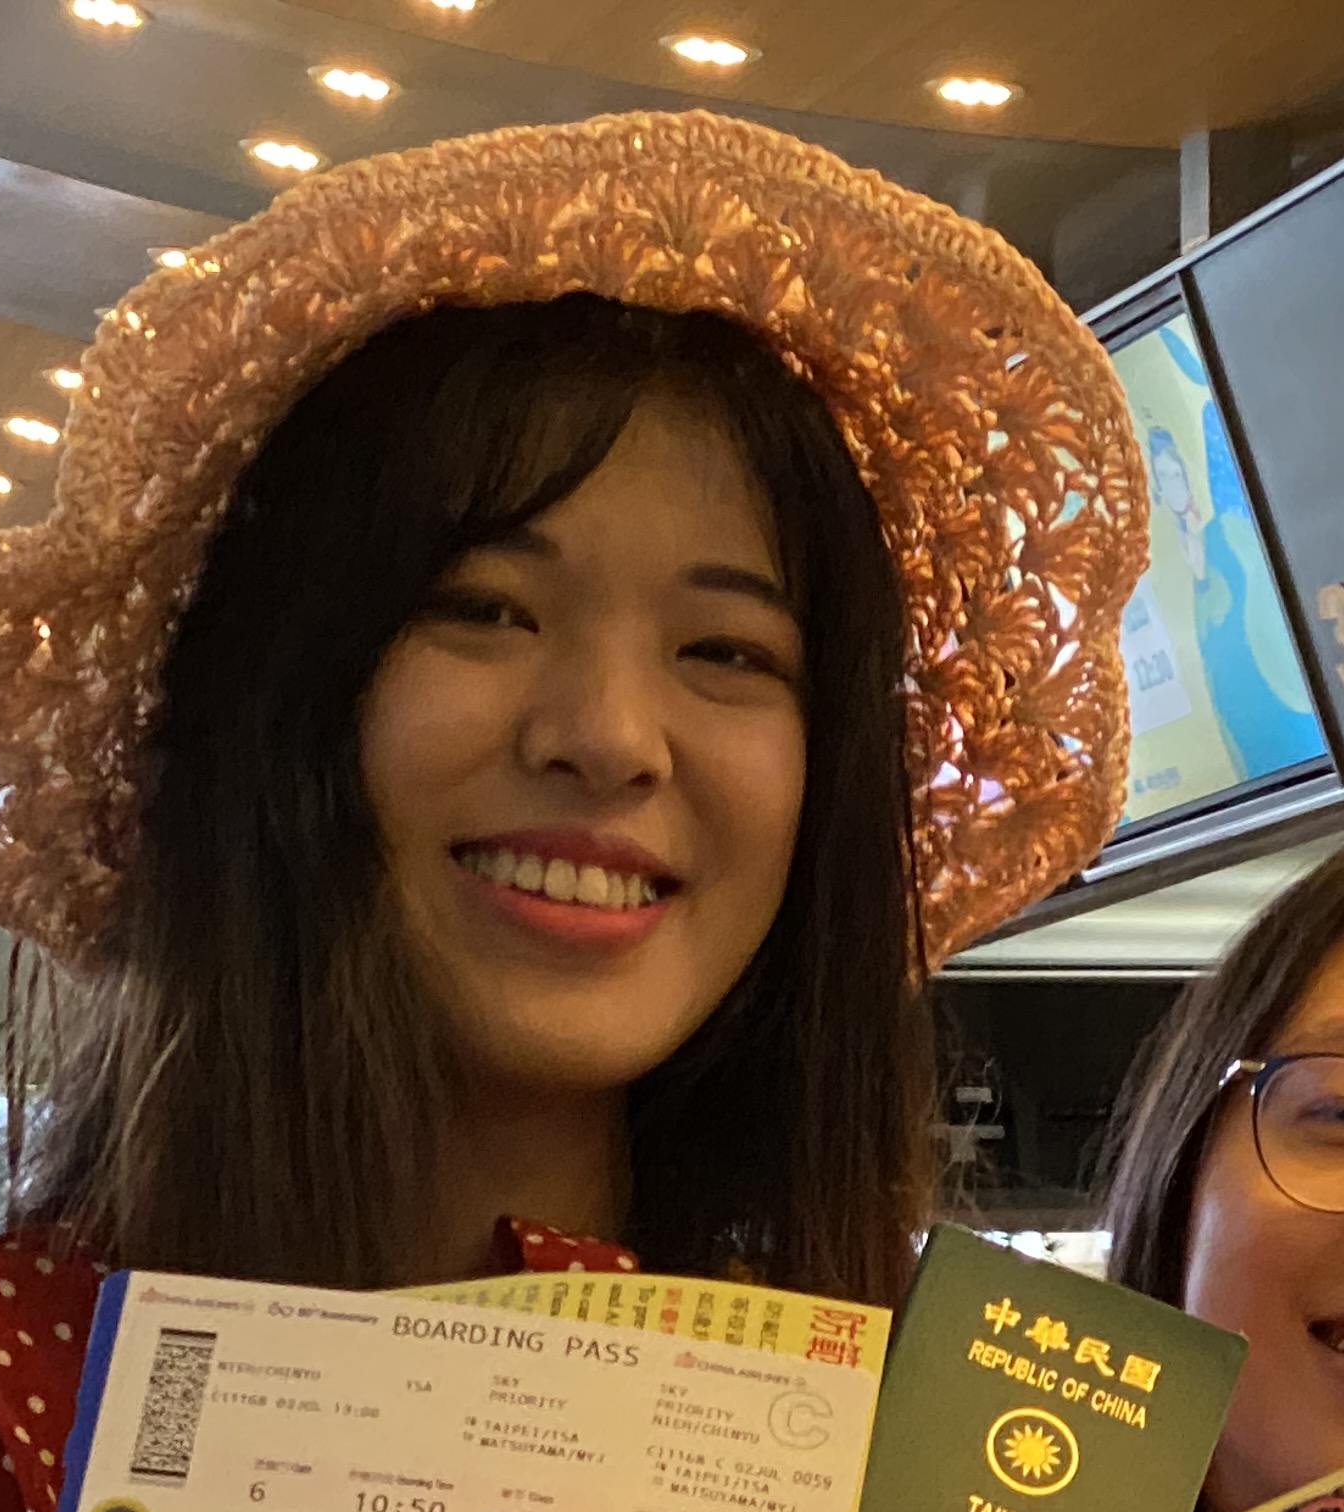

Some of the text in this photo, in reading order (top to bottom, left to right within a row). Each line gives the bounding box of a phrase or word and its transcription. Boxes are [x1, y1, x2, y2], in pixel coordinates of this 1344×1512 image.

[392, 1315, 641, 1368] BOARDING PASS
[983, 1297, 1162, 1393] 中華民國
[967, 1339, 1147, 1429] REPUBLIC OF CHINA
[249, 1480, 267, 1503] 6
